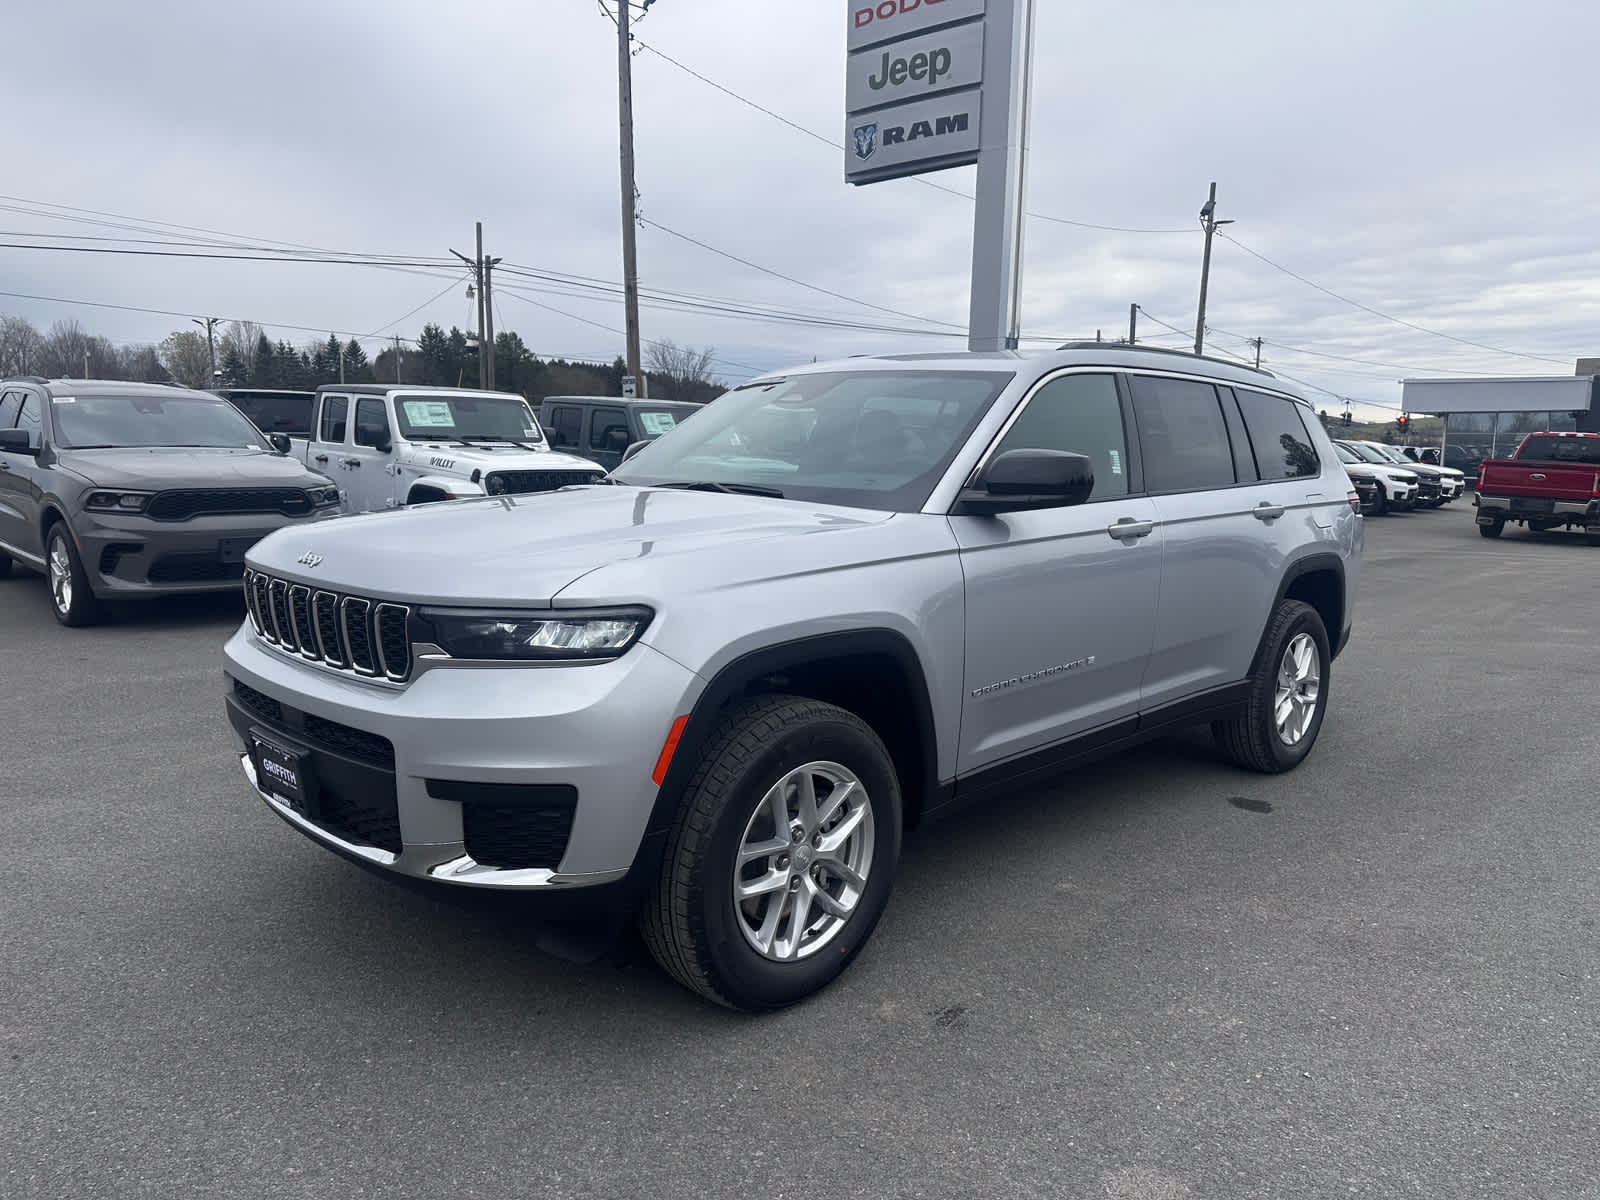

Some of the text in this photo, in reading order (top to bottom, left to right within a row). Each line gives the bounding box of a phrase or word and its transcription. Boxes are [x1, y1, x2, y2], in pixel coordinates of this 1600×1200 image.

[855, 0, 946, 28] DOD
[868, 47, 952, 90] Jeep
[882, 113, 969, 146] RAM
[263, 758, 297, 785] GRIFFITH
